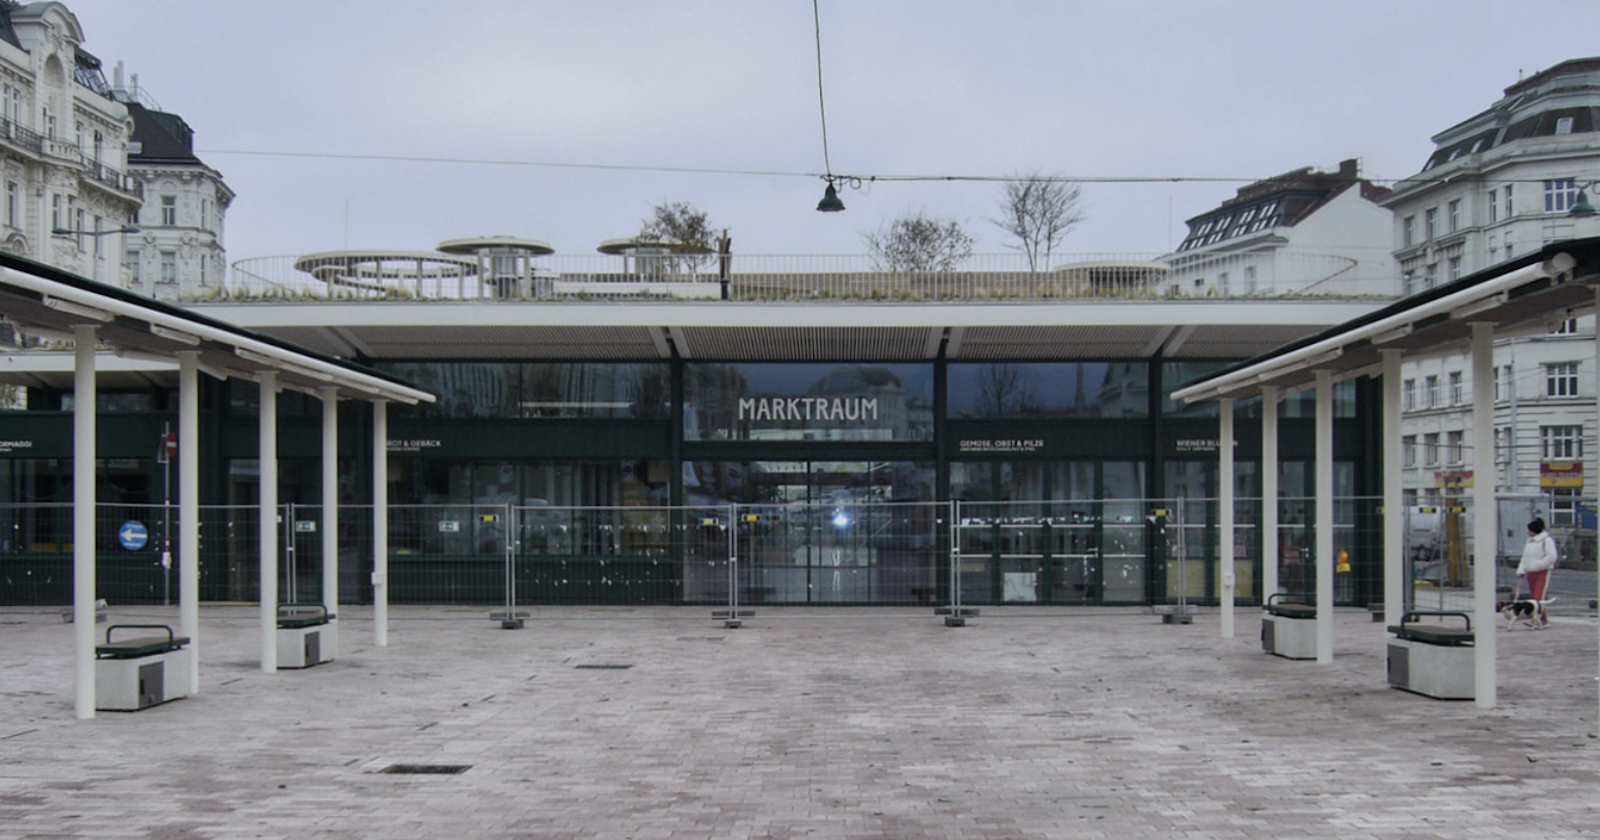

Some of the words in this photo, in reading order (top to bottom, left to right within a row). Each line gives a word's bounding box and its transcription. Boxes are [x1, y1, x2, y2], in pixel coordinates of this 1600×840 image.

[739, 398, 877, 420] MARKTRAUM
[995, 439, 1015, 447] OBST
[1176, 439, 1206, 447] WIENER
